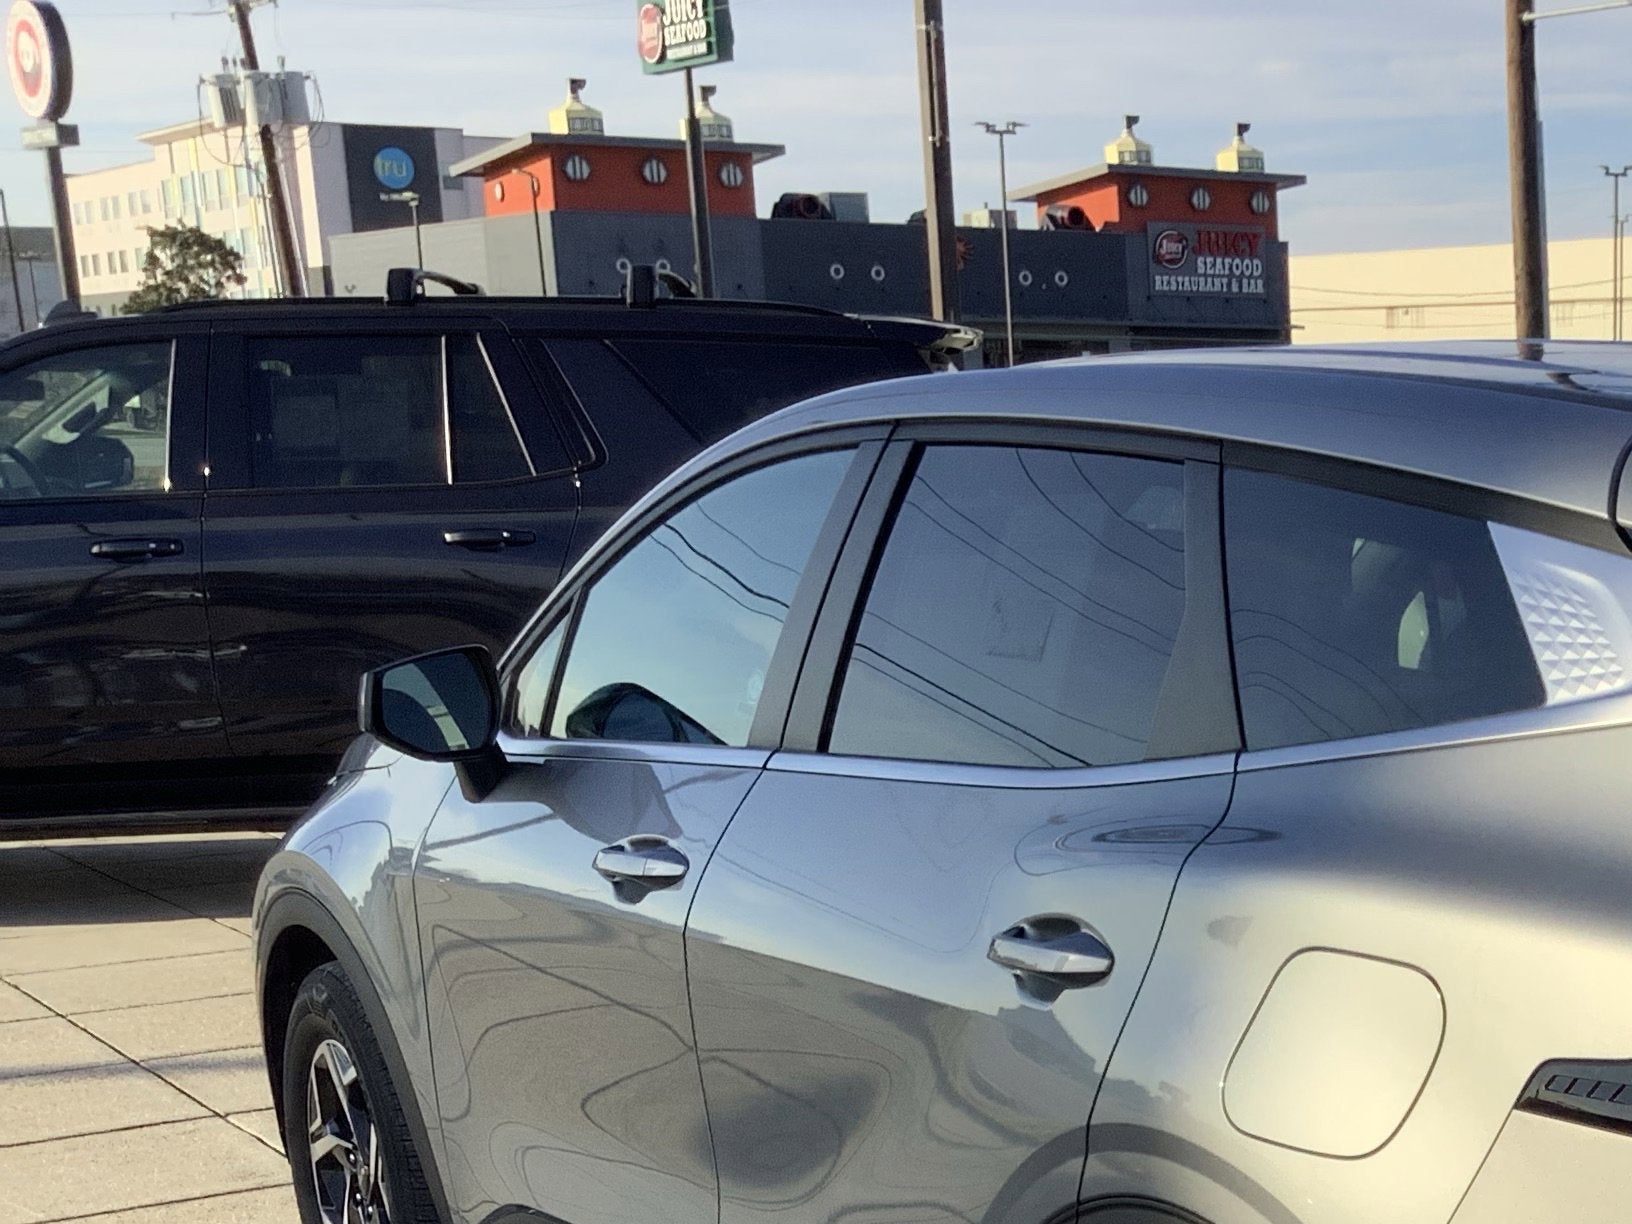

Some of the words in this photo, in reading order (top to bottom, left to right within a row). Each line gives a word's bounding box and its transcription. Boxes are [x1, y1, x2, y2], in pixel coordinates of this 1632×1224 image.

[664, 19, 707, 46] SEAFOOD
[1193, 231, 1259, 256] JUICY
[1197, 257, 1263, 276] SEAFOOD
[1155, 276, 1228, 292] RESTAURANT
[1242, 279, 1265, 293] BAR
